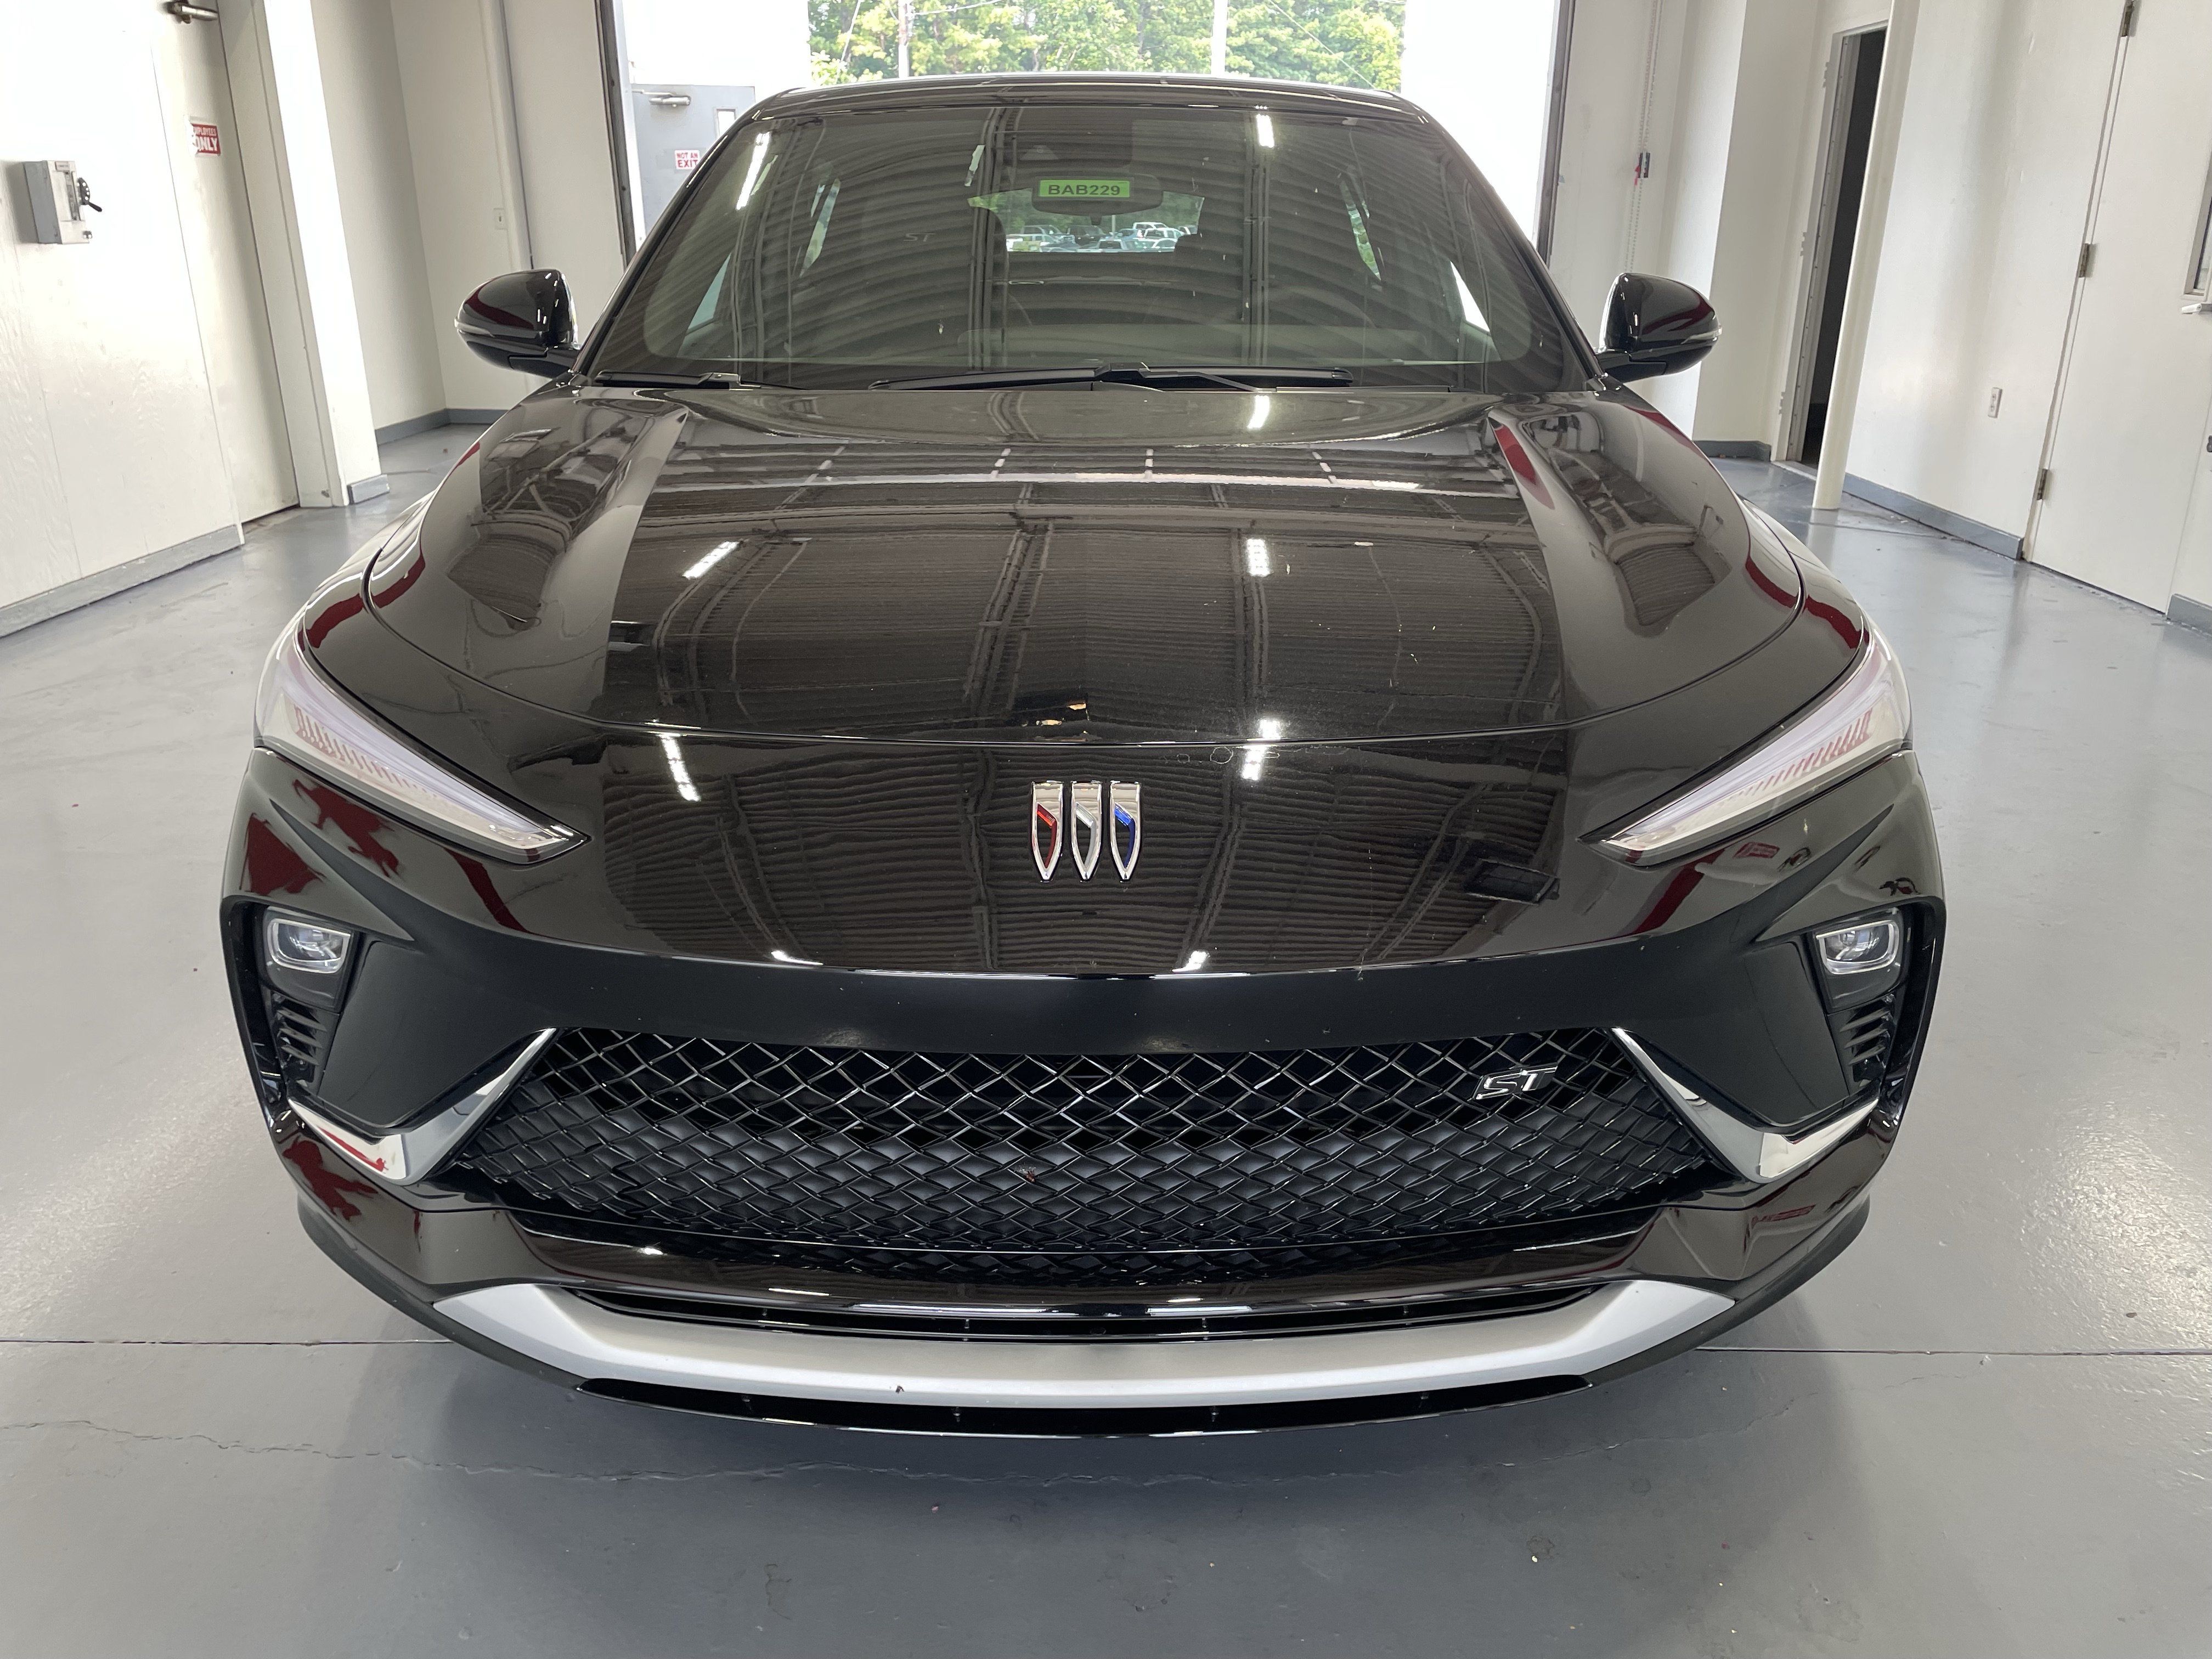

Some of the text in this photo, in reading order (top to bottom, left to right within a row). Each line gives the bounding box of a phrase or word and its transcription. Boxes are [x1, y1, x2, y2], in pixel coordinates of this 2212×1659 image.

[193, 136, 218, 151] ONLY
[1048, 184, 1120, 195] BAB229
[1476, 1066, 1558, 1100] ST
